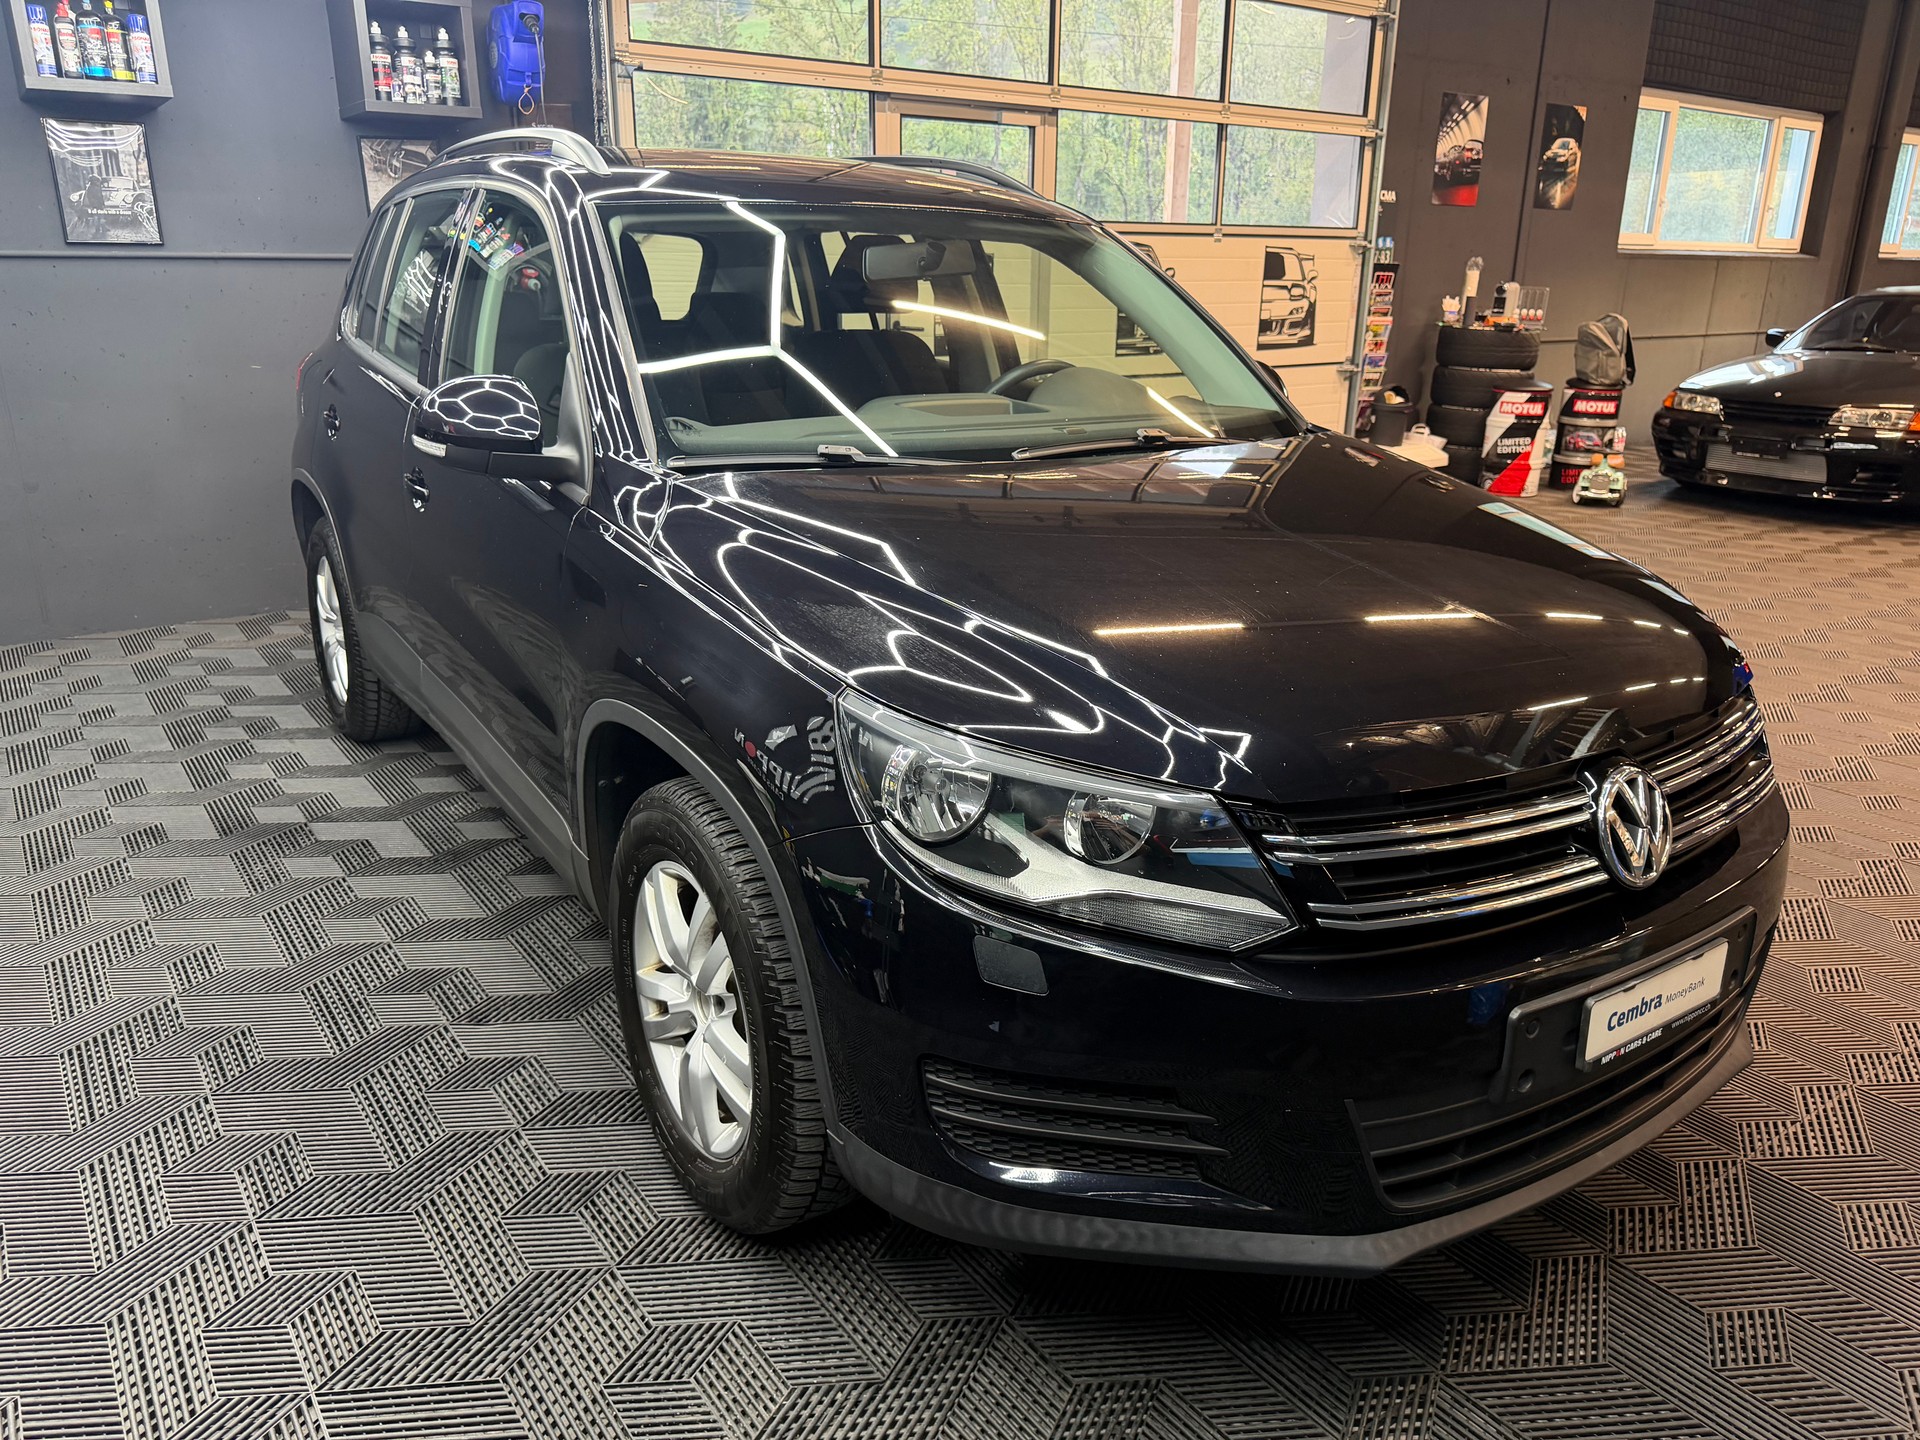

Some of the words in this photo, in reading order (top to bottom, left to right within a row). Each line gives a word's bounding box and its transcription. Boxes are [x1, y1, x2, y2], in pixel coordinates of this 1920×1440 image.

[1501, 402, 1544, 416] MOTUL
[1575, 400, 1617, 414] MOTUL
[1497, 437, 1531, 446] LIMITED
[1496, 445, 1532, 454] EDITION
[1607, 993, 1663, 1032] Cembra
[1664, 976, 1706, 1005] MoneyBank
[1625, 1038, 1642, 1053] CARS
[1647, 1027, 1663, 1042] CARE
